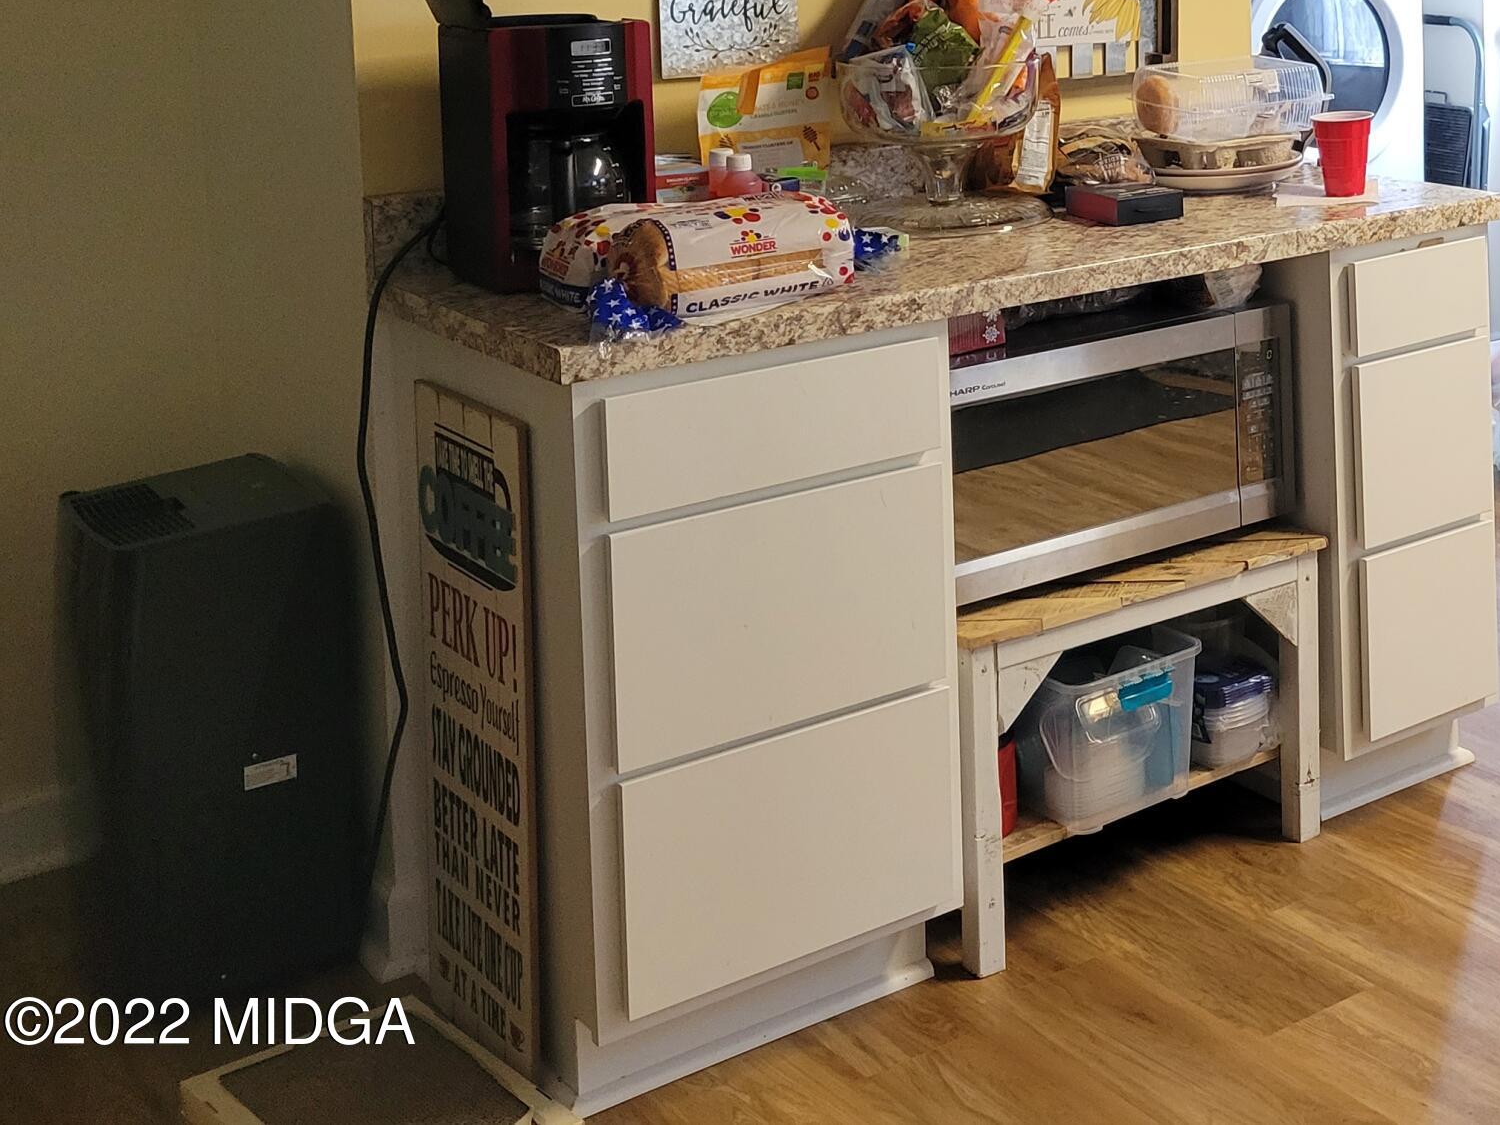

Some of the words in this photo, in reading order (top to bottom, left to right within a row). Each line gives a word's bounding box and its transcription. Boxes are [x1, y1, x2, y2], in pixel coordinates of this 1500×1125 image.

[685, 291, 761, 314] CLASSIC
[764, 280, 820, 298] WHITE
[731, 240, 777, 256] WONDER
[950, 384, 981, 397] HARP
[418, 465, 518, 585] COFFEE
[428, 572, 480, 668] PERK
[483, 606, 518, 694] UP!
[430, 650, 479, 715] Espresso
[479, 683, 520, 757] Yourself
[432, 703, 456, 777] STAY
[458, 723, 521, 826] GROUNDED
[433, 777, 480, 862] BETTER
[483, 817, 519, 895] LATTE
[435, 830, 469, 891] THAN
[475, 864, 521, 937] NEVER
[436, 878, 461, 954] TAKE
[462, 900, 484, 974] LIFE
[485, 921, 504, 994] ONE
[505, 941, 523, 1011] CUP
[454, 963, 467, 1002] AT
[470, 980, 479, 1015] A
[480, 987, 506, 1041] TIME
